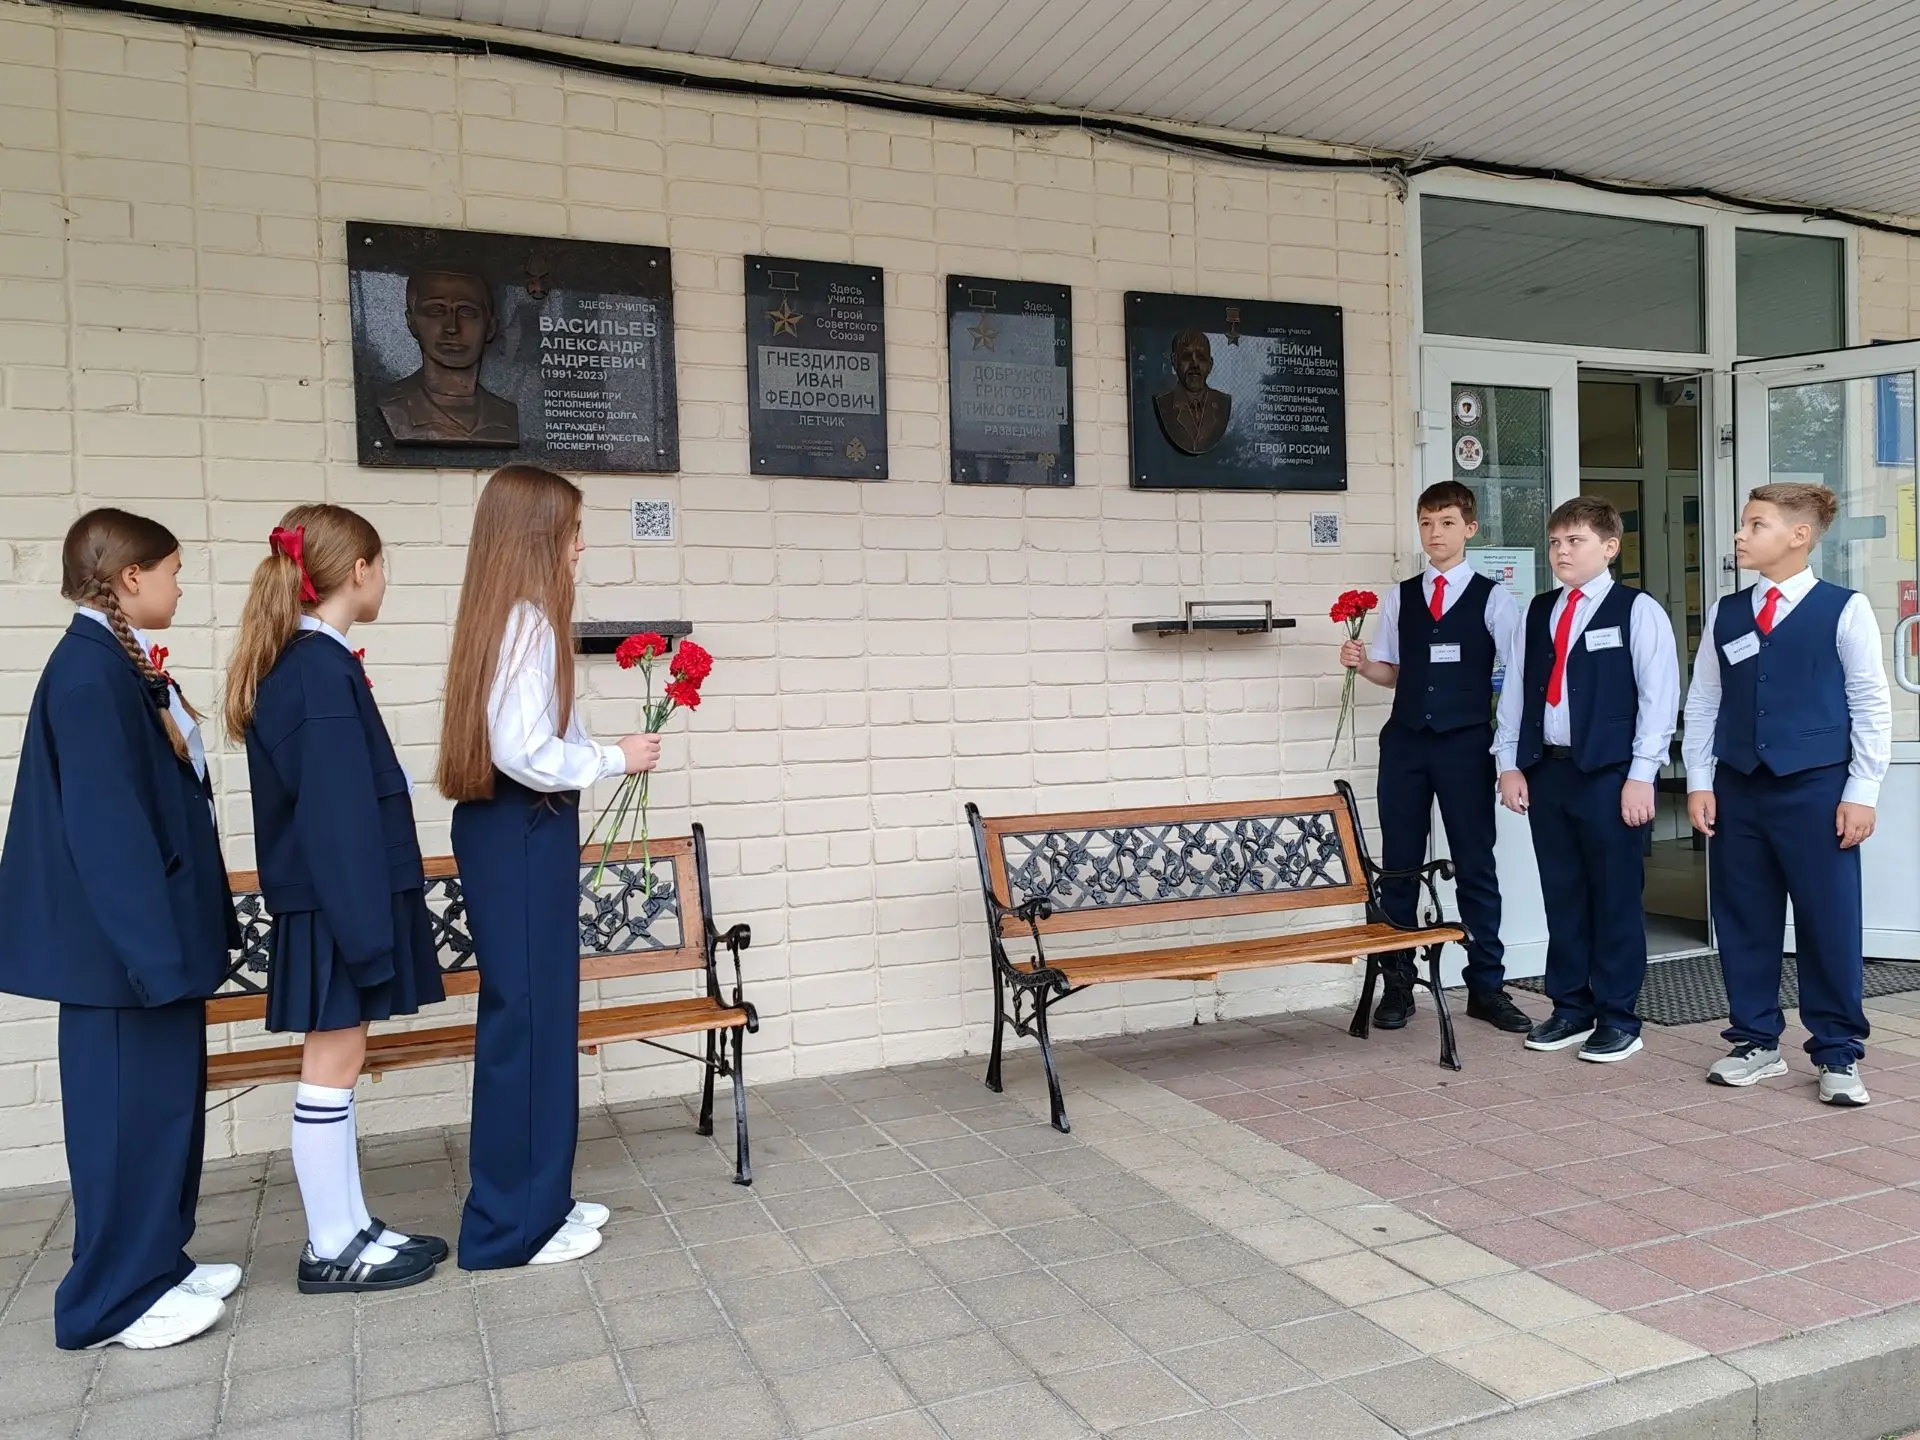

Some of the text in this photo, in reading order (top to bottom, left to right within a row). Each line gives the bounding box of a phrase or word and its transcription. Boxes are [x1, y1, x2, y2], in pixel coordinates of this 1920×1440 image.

[830, 283, 862, 295] Здесь
[579, 300, 656, 312] ЗДЕСЬ УЧИЛСЯ
[828, 295, 864, 305] учился
[1024, 301, 1052, 312] Здесь
[831, 307, 863, 320] Герой
[540, 317, 657, 337] ВАСИЛЬЕВ
[817, 318, 877, 331] Советского
[830, 330, 865, 342] Союза
[540, 337, 643, 354] АЛЕКСАНДР
[1258, 342, 1322, 356] ОПЕЙКИН
[541, 354, 646, 369] АНДРЕЕВИЧ
[767, 351, 870, 371] ГНЕЗДИЛОВ
[1273, 356, 1338, 368] ГЕННАДЬЕВИЧ
[541, 370, 607, 381] (1991-2023)
[796, 372, 843, 389] ИВАН
[602, 392, 621, 400] ПРИ
[766, 390, 873, 409] ФЕДОРОВИЧ
[1264, 394, 1318, 404] ПРОЯВЛЕННЫЕ
[545, 401, 611, 409] ИСПОЛНЕНИИ
[1257, 403, 1325, 413] ПРИ ИСПОЛНЕНИИ
[546, 410, 638, 420] ВОИНСКОГО ДОЛГА
[799, 415, 844, 427] ЛЕТЧИК
[1255, 413, 1299, 422] ВОИНСКОГО
[985, 424, 1047, 438] РАЗВЕДЧИК
[1254, 423, 1330, 433] ПРИСВОЕНО ЗВАНИЕ
[546, 433, 649, 442] ОРДЕНОМ МУЖЕСТВА
[547, 442, 614, 451] (ПОСМЕРТНО)
[1255, 442, 1330, 455] ГЕРОЙ РОССИИ
